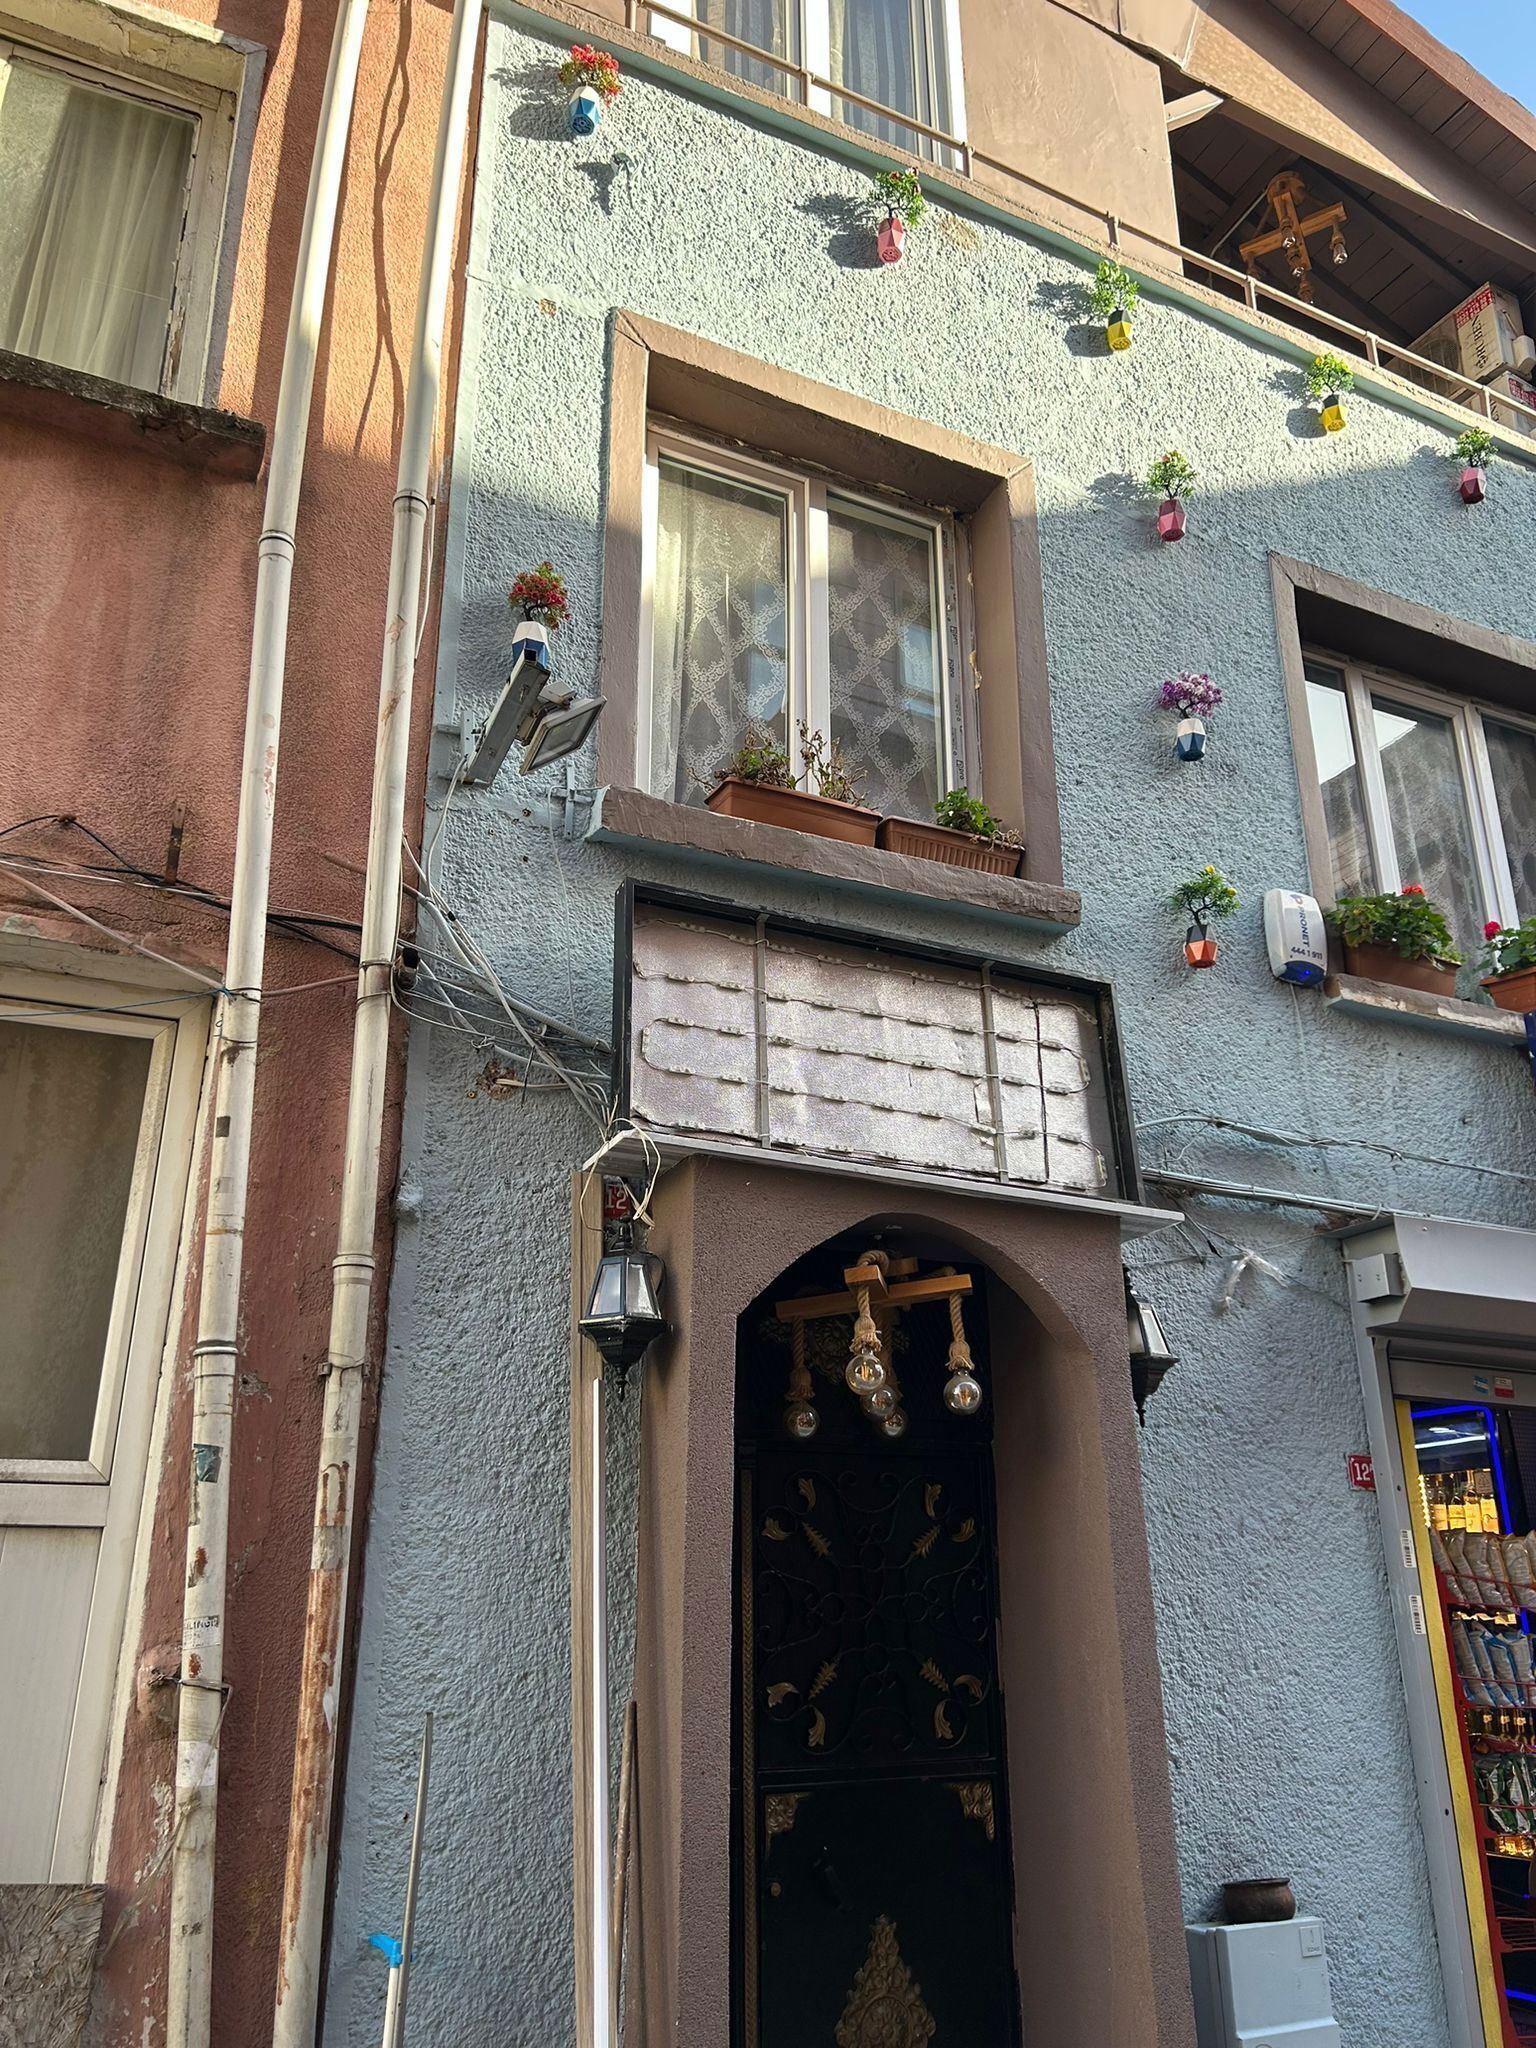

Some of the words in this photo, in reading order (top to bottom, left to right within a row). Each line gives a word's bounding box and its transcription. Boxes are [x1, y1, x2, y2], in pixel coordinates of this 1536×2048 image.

[1298, 906, 1310, 948] PRONET
[1291, 946, 1306, 956] 444
[606, 1188, 627, 1209] 12
